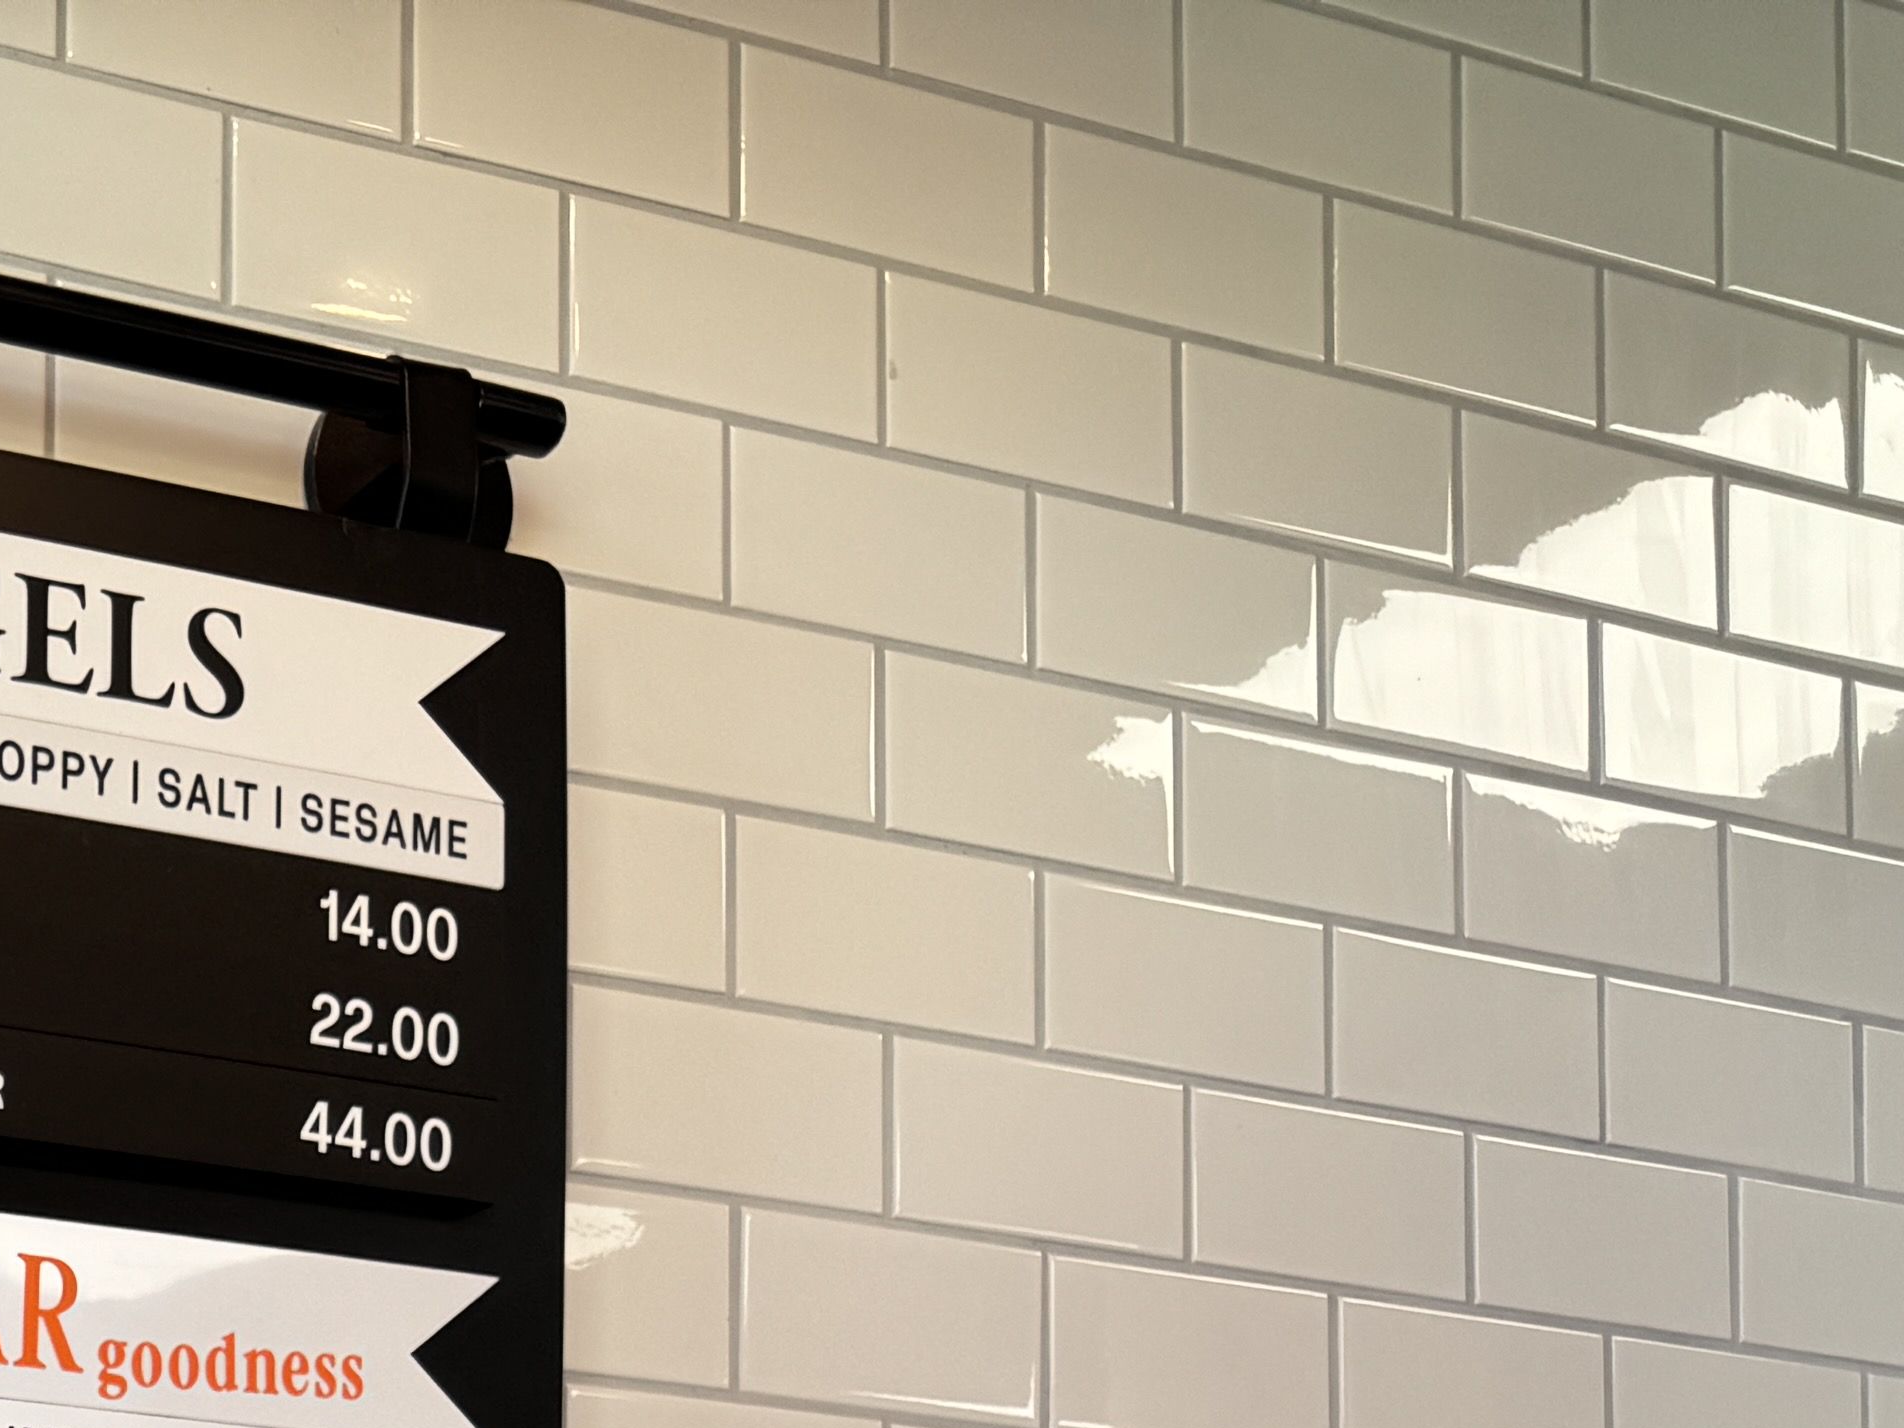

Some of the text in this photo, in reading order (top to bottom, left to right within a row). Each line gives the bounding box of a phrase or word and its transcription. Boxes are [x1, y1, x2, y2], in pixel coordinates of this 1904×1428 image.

[157, 767, 258, 822] SALT
[300, 792, 468, 860] SESAME
[320, 889, 458, 961] 14.00
[309, 993, 459, 1066] 22.00
[300, 1100, 452, 1172] 44.00
[96, 1328, 366, 1403] goodness
